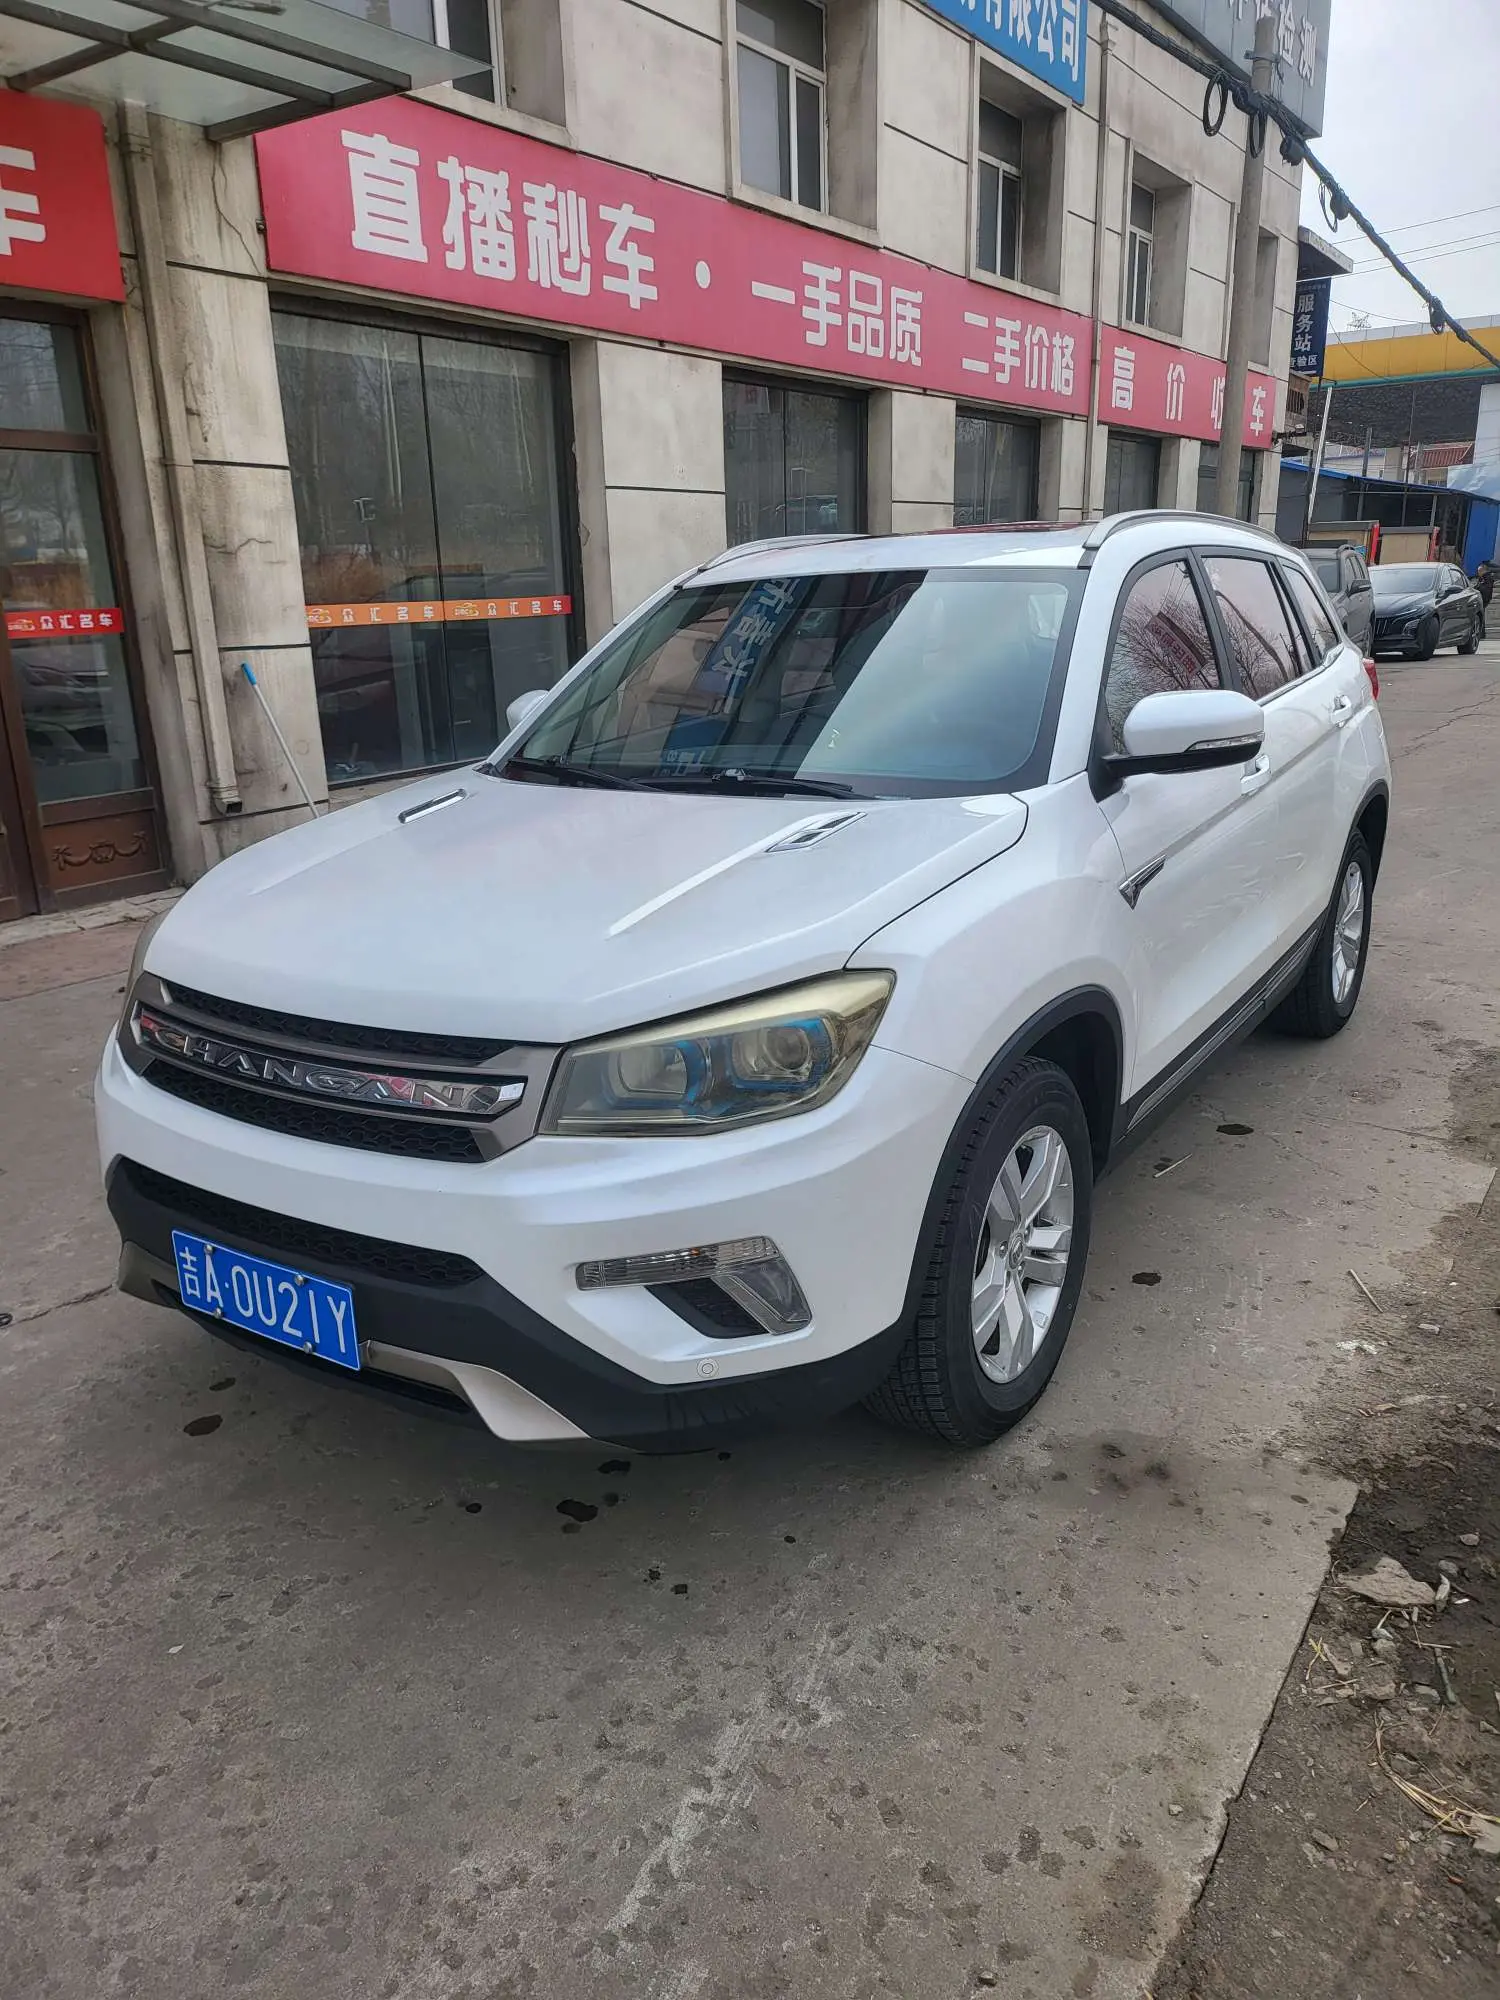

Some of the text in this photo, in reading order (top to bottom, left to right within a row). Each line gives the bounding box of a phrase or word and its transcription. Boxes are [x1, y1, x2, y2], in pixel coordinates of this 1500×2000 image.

[751, 260, 923, 367] 一手品质
[961, 311, 1076, 396] 二手价格
[1294, 294, 1315, 353] 服务站
[154, 1026, 464, 1109] CHANGAN
